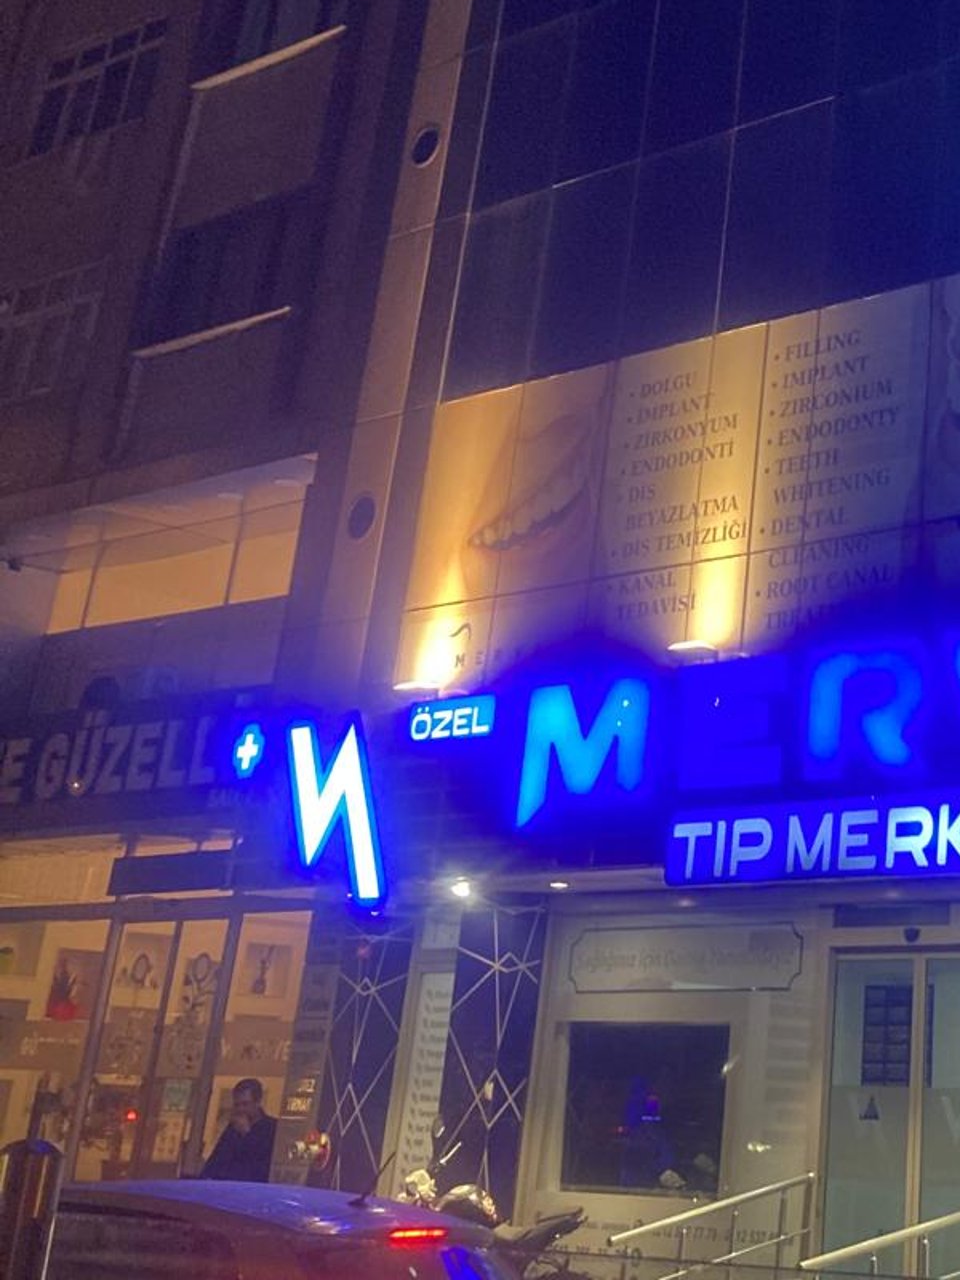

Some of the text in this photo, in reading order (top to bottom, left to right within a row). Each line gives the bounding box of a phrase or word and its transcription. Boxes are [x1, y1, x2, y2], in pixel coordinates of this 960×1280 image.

[783, 329, 863, 362] FILLING
[782, 355, 871, 390] IMPLANT
[779, 377, 894, 418] ZIRCONIUM
[773, 447, 840, 477] TEETH
[771, 468, 893, 506] WHITENING
[625, 494, 739, 531] BEYAZLATMA
[410, 706, 490, 742] ÖZEL
[673, 817, 774, 880] TIP
